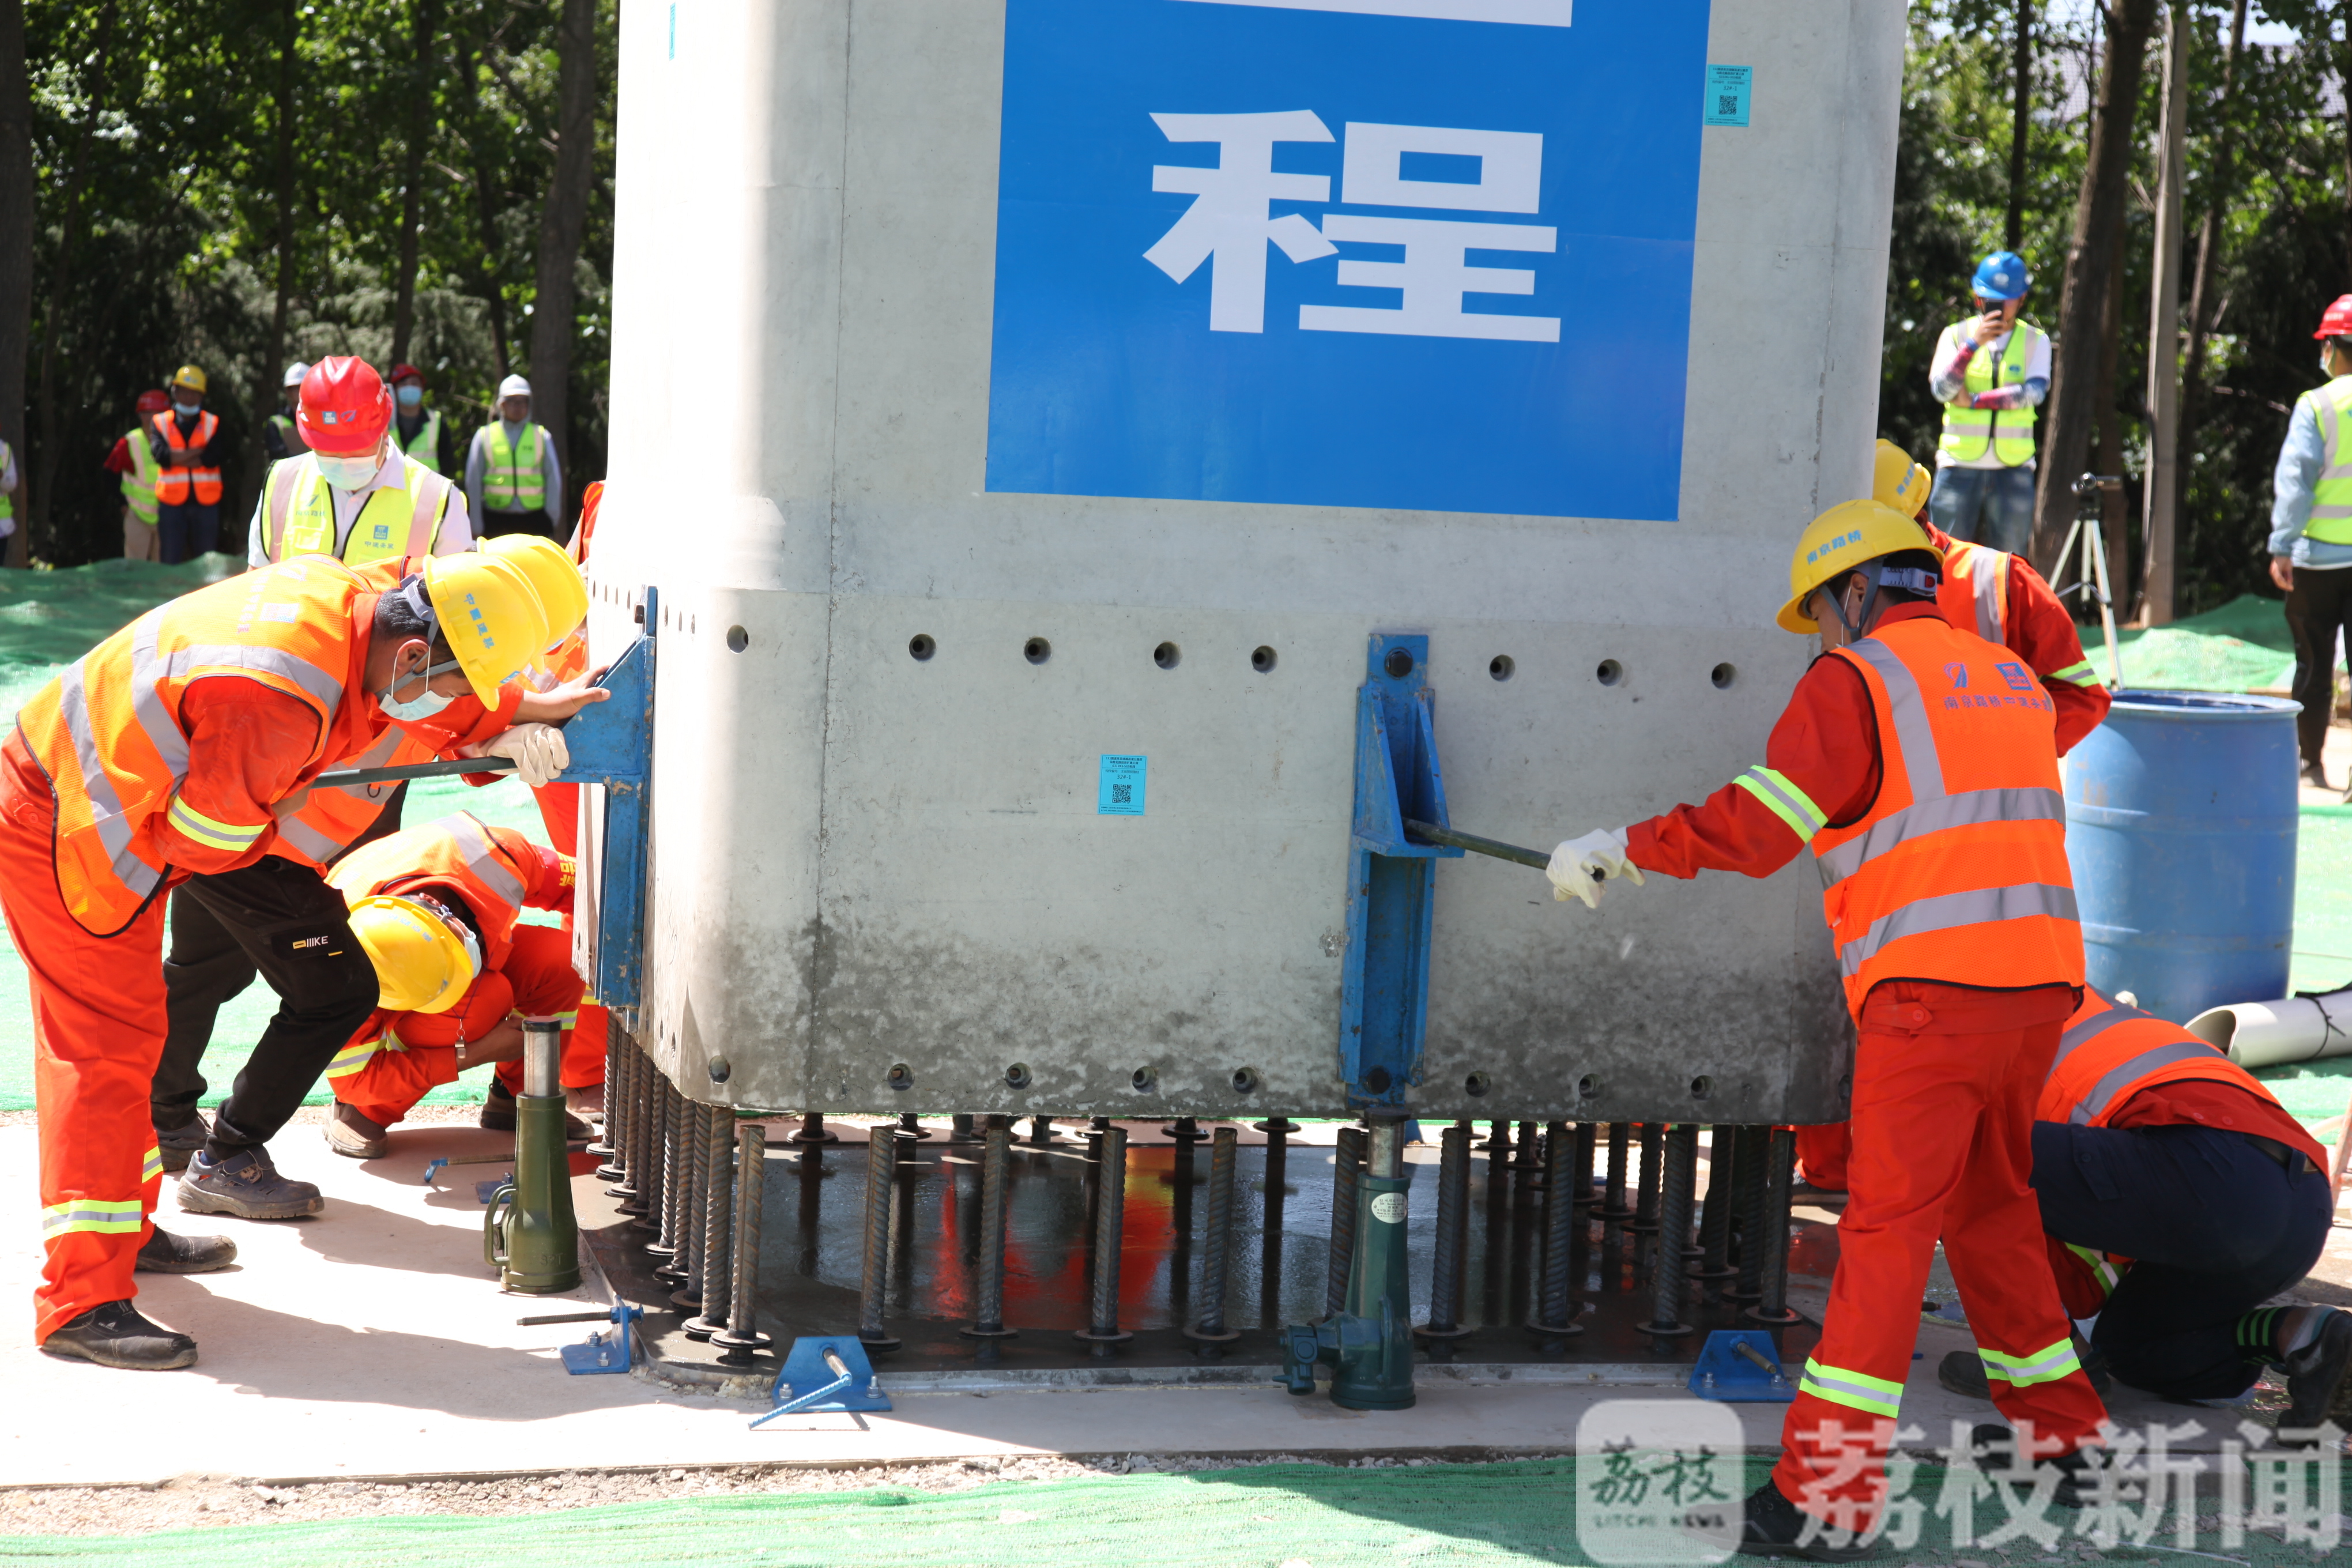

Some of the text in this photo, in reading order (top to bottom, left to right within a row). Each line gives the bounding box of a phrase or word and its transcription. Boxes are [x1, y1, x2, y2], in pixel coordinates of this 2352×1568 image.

[1142, 109, 1561, 342] 程
[1807, 529, 1862, 566] 南京路桥
[1943, 695, 2003, 710] 南京路桥
